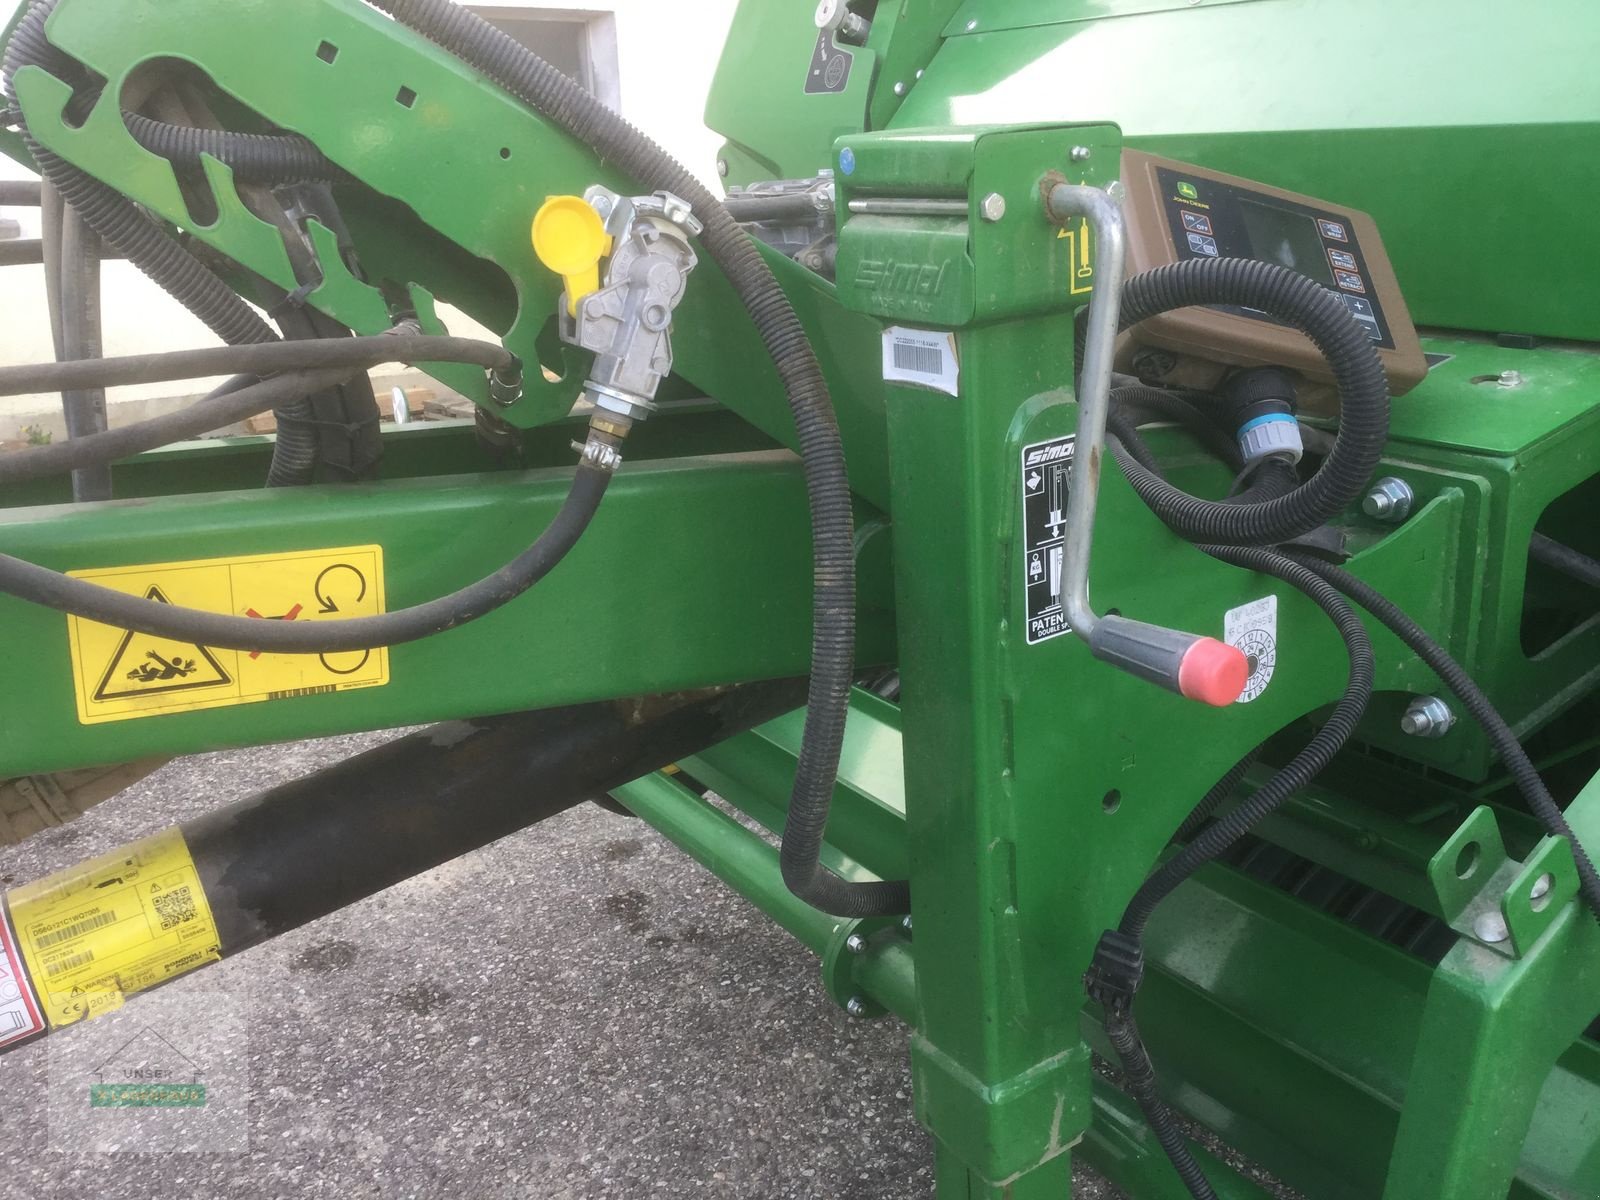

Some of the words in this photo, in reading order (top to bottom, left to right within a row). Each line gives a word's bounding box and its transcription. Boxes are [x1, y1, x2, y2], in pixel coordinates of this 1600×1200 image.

[1173, 196, 1189, 205] JOHN
[1190, 200, 1210, 210] DEERE
[1185, 214, 1195, 222] ON
[1038, 625, 1061, 638] DOUBLE
[85, 972, 120, 989] WARNING
[90, 991, 116, 1008] 2019
